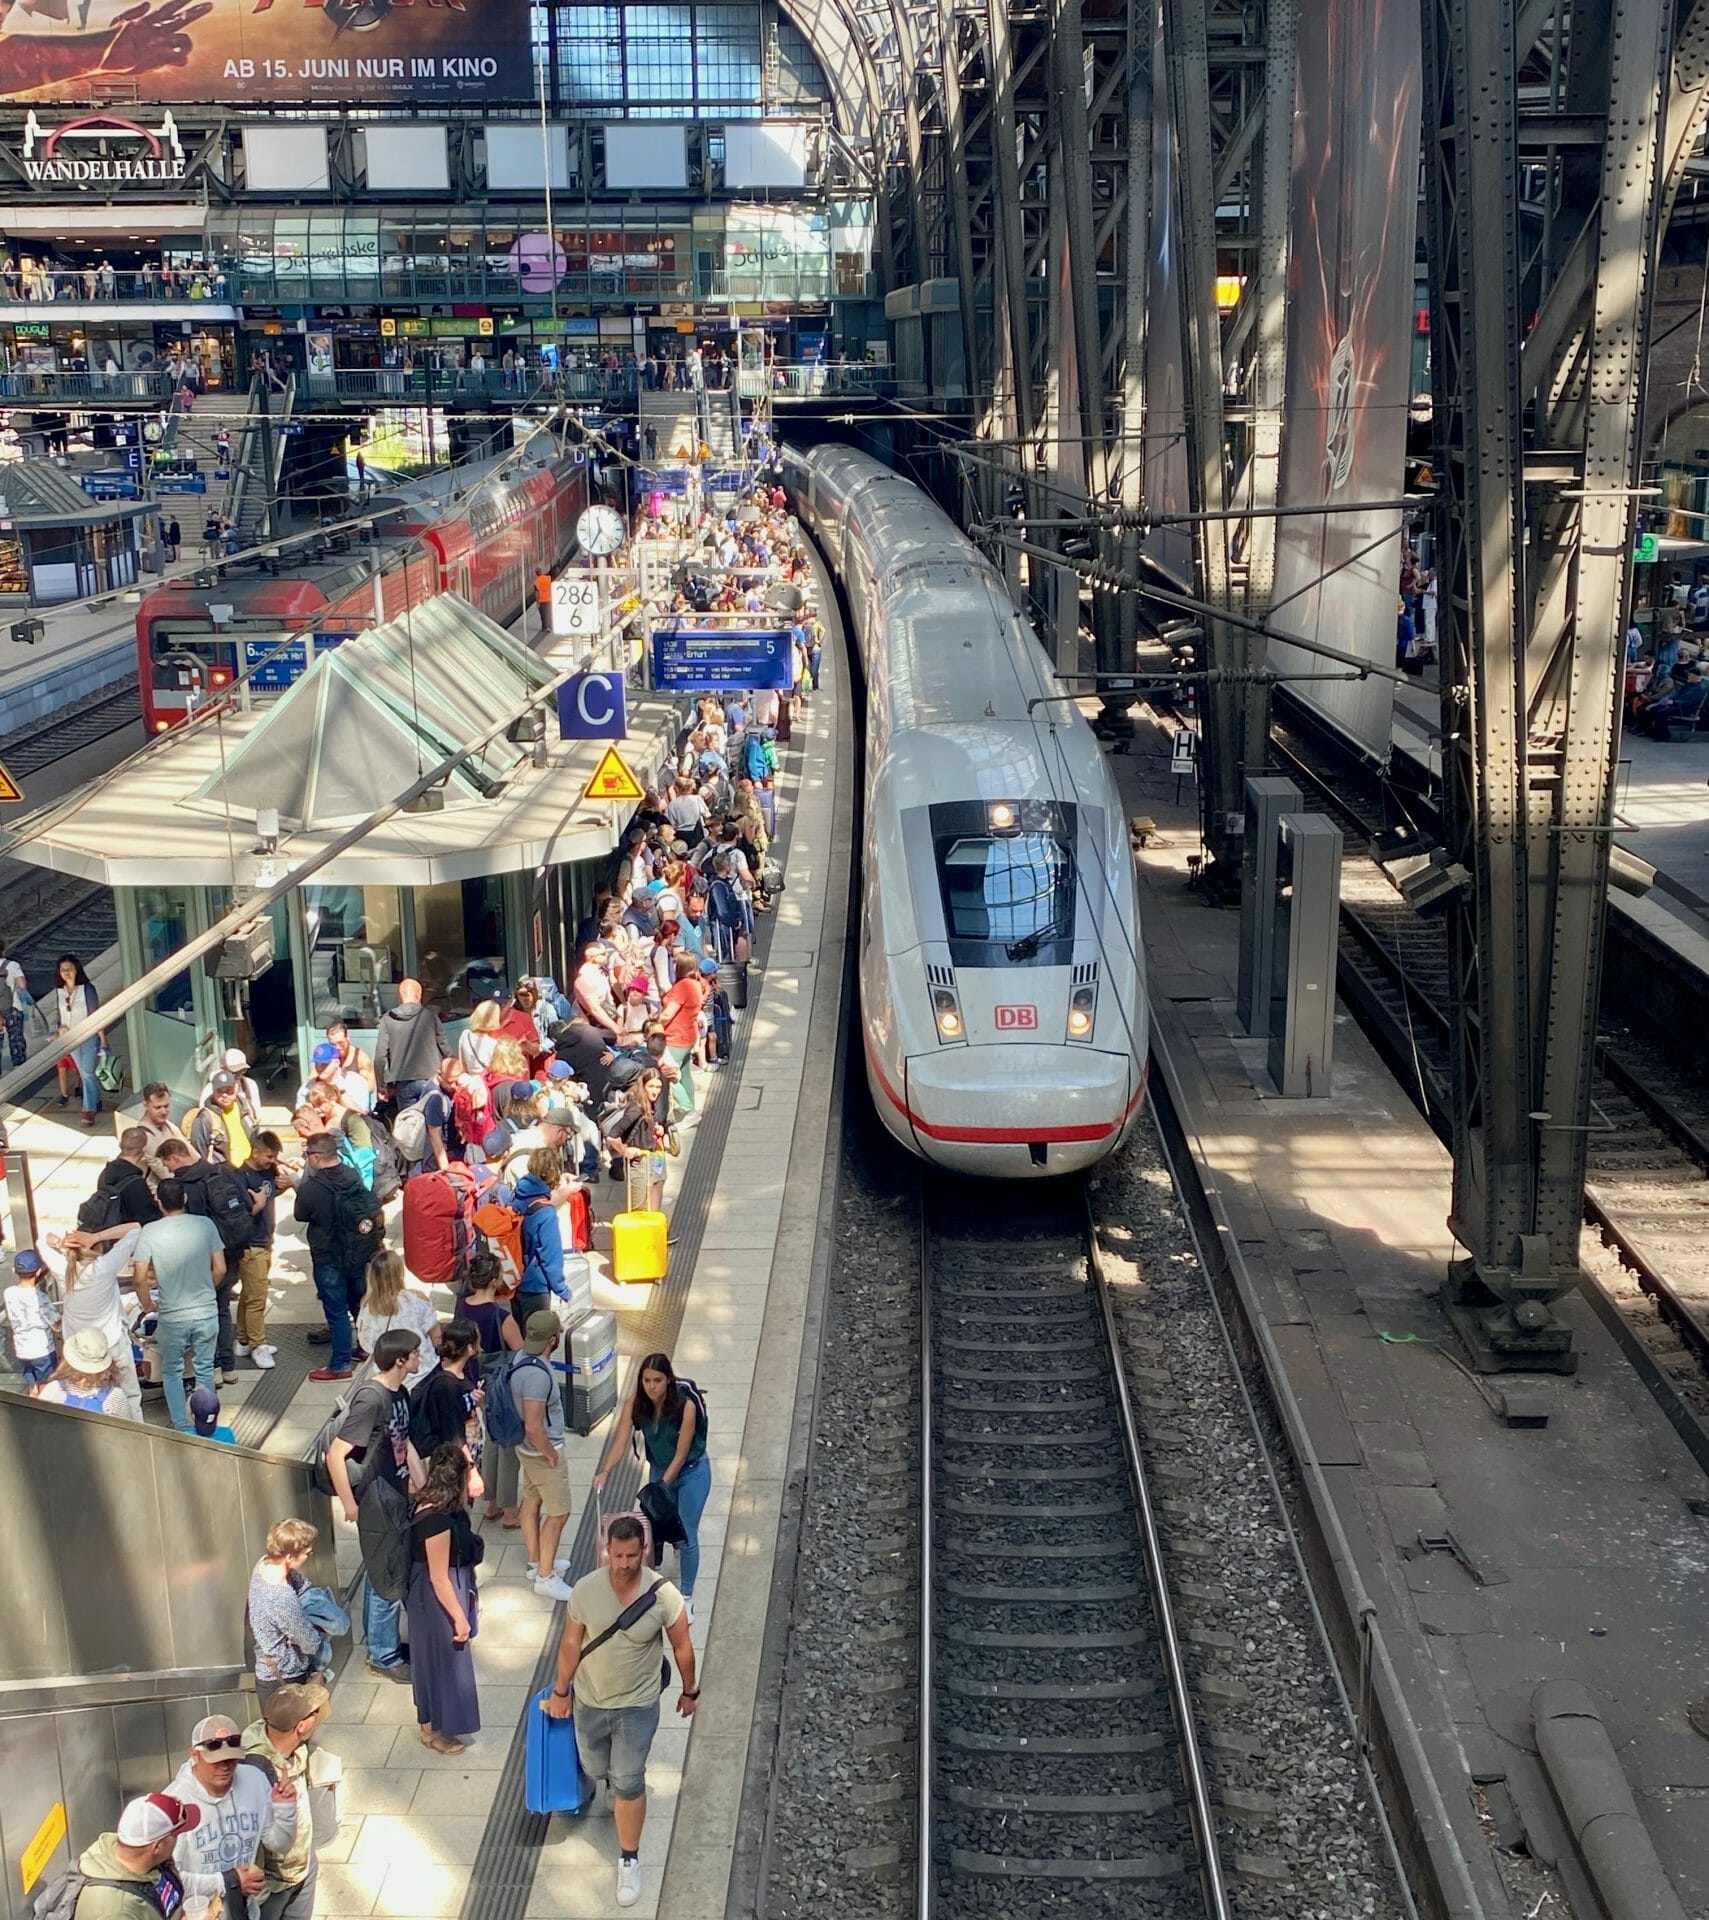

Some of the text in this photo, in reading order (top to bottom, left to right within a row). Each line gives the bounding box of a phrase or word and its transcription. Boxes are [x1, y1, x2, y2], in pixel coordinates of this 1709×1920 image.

[223, 57, 498, 78] AB 15. JUNI NUR IM KINO
[23, 160, 186, 181] WANDELHALLE
[129, 453, 138, 467] E
[574, 450, 585, 463] D
[556, 585, 594, 605] 286
[570, 608, 583, 628] 6
[246, 643, 256, 656] 6
[686, 650, 708, 659] Erfurt
[766, 640, 776, 655] 5
[577, 674, 614, 726] C
[1175, 732, 1193, 758] H
[1000, 1008, 1033, 1026] DB
